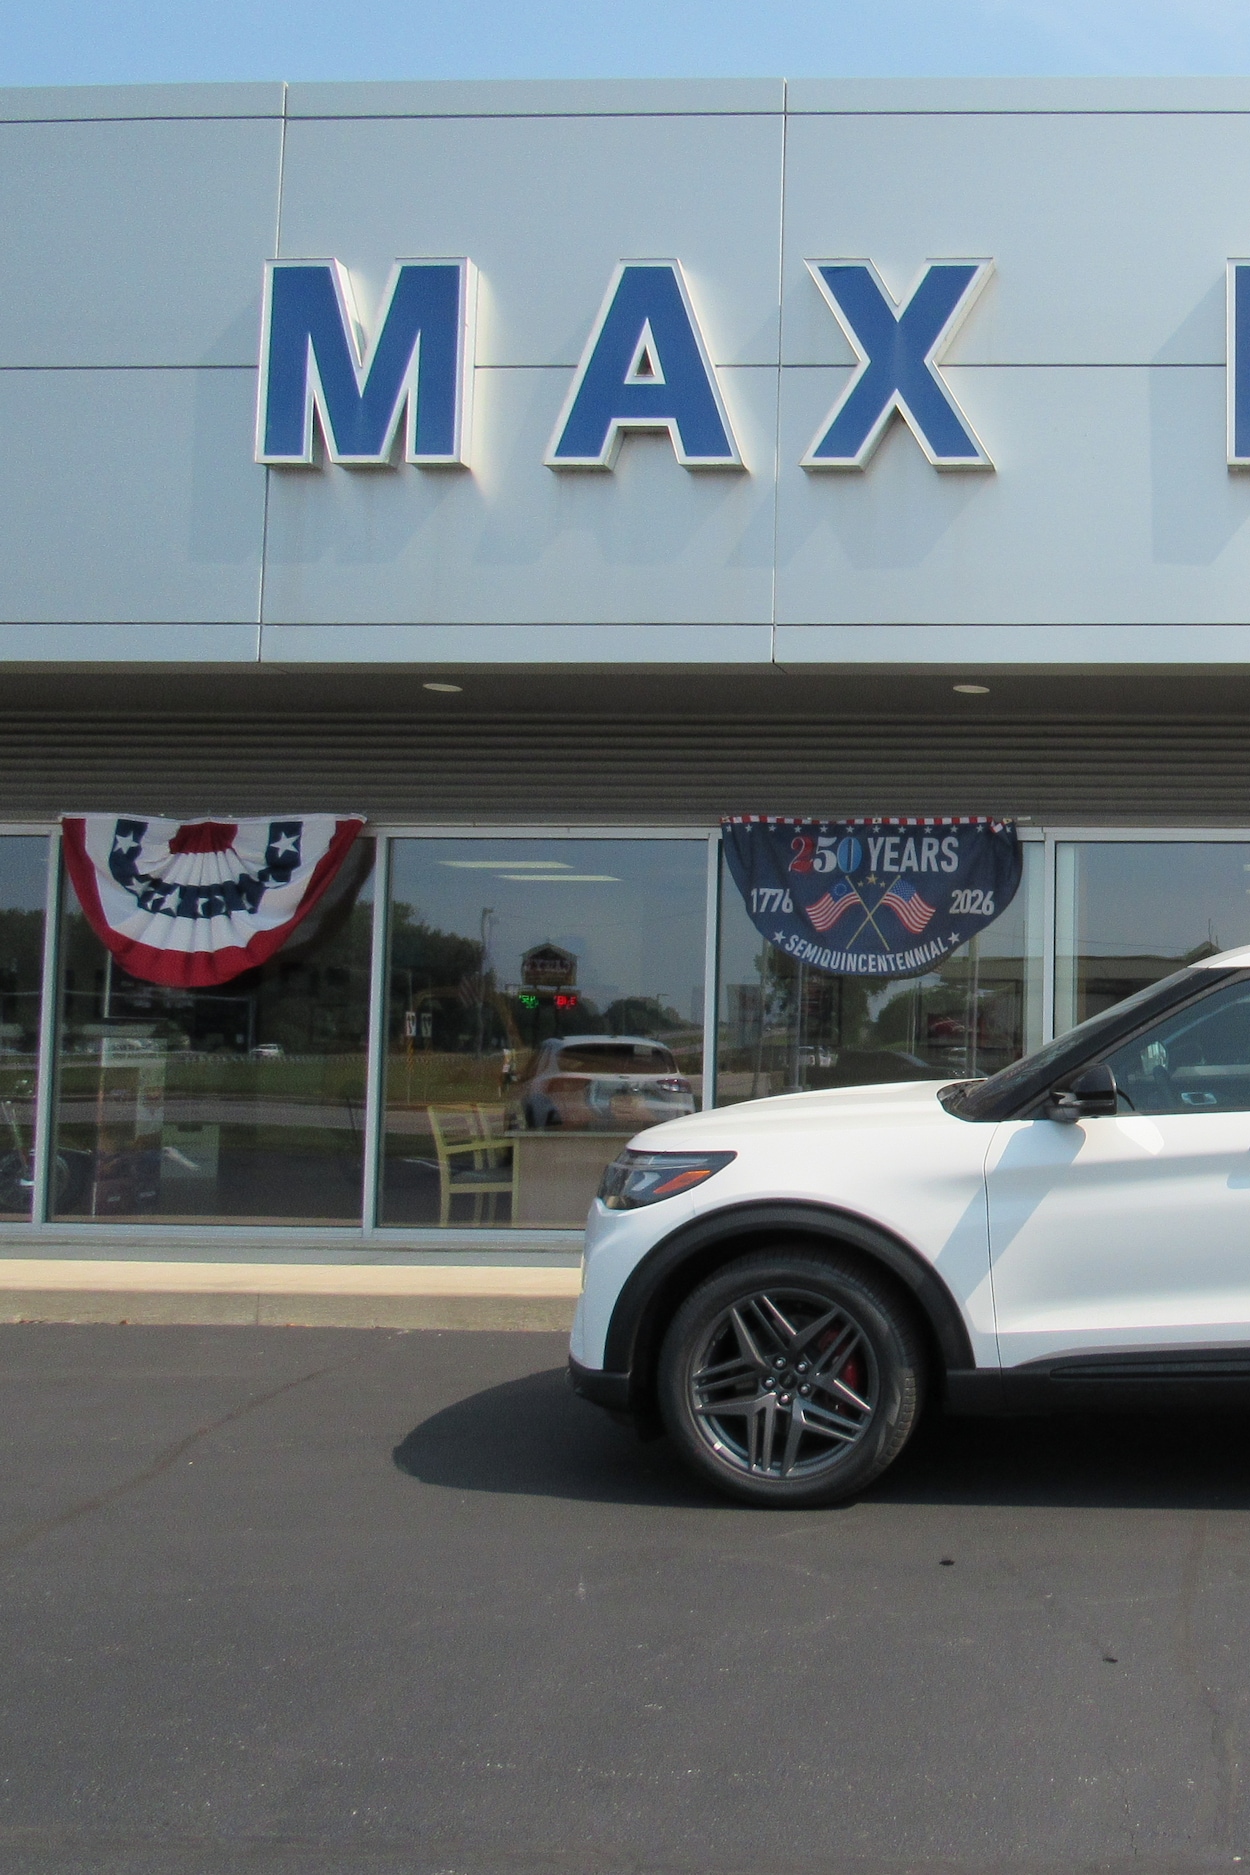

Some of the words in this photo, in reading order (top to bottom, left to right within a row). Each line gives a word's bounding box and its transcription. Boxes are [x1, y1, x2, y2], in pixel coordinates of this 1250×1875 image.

[255, 257, 997, 471] MAX
[788, 835, 863, 874] 250
[867, 836, 959, 873] YEARS
[750, 887, 793, 914] 1776
[949, 889, 995, 916] 2026
[785, 934, 949, 973] SEMIQUINCENTENNIAL
